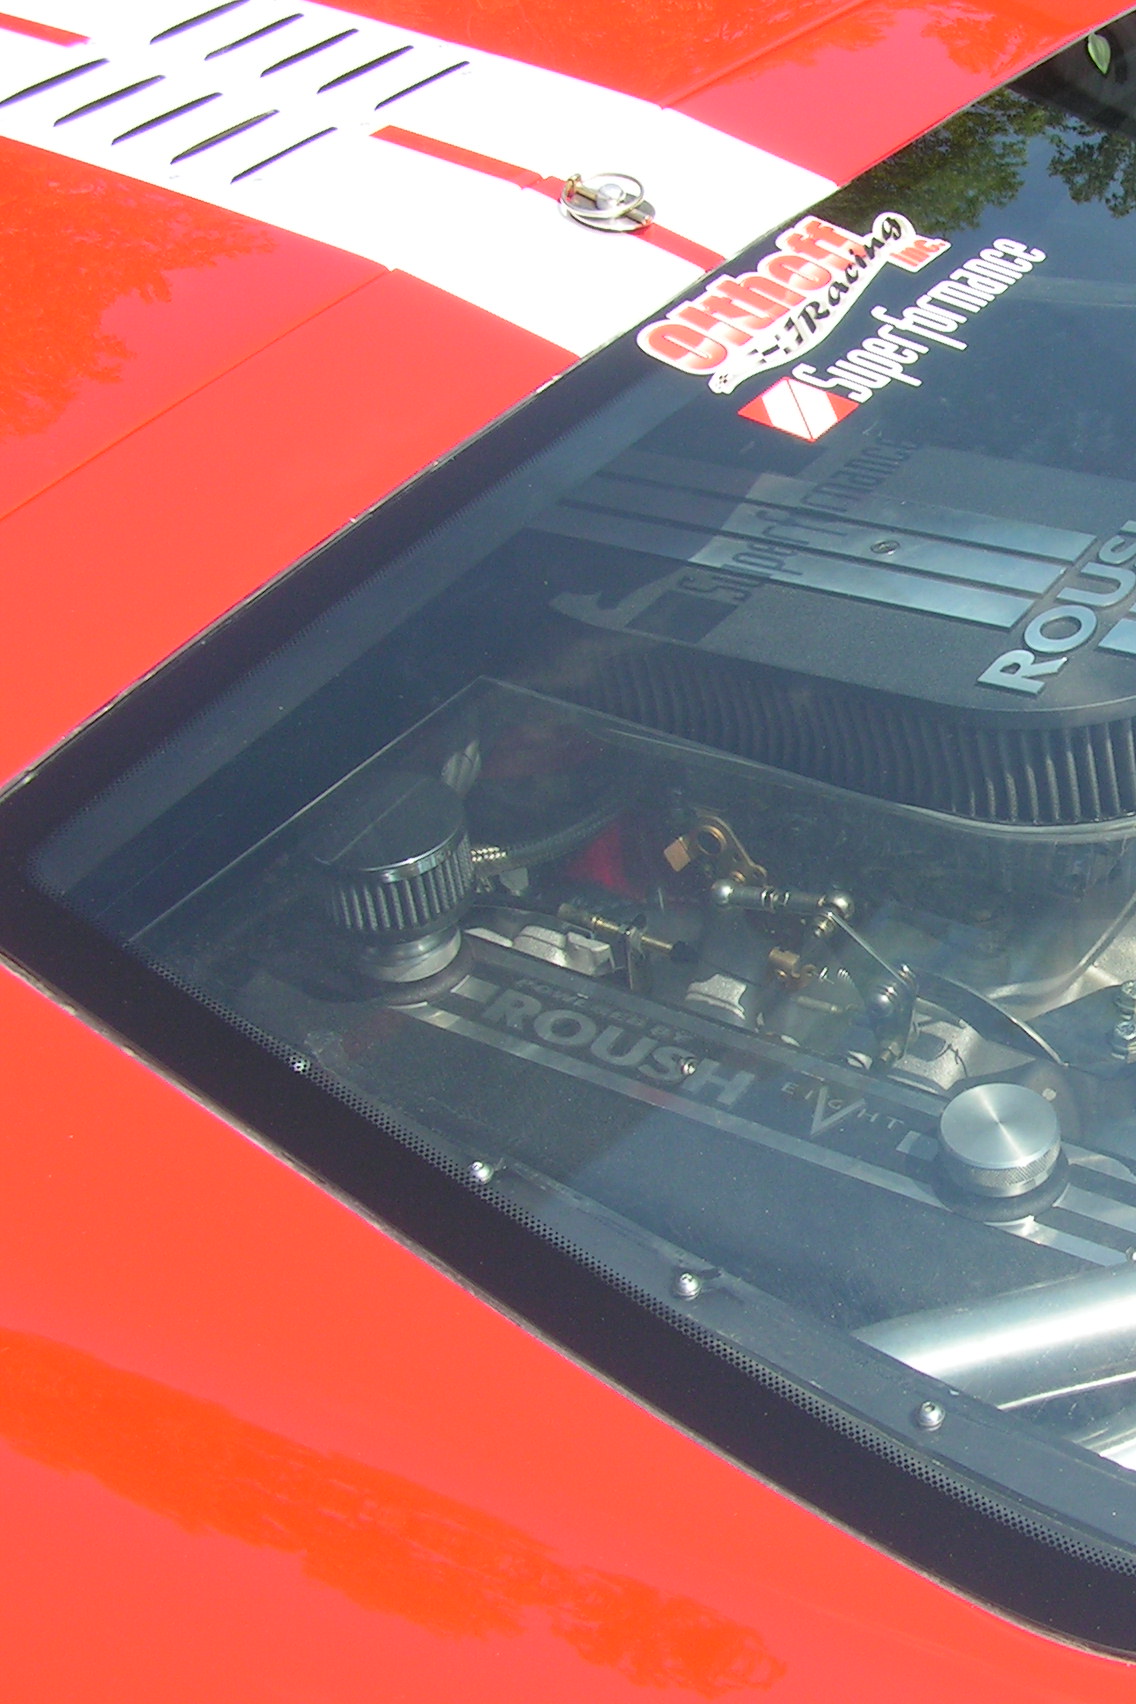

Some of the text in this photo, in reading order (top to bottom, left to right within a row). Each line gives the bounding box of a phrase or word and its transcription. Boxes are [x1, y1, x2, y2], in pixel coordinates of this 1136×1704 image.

[646, 217, 870, 373] Olthoff
[791, 237, 1047, 404] Superformance
[794, 216, 903, 338] Racing
[482, 989, 756, 1107] ROUSH
[781, 1081, 905, 1130] EIGHT
